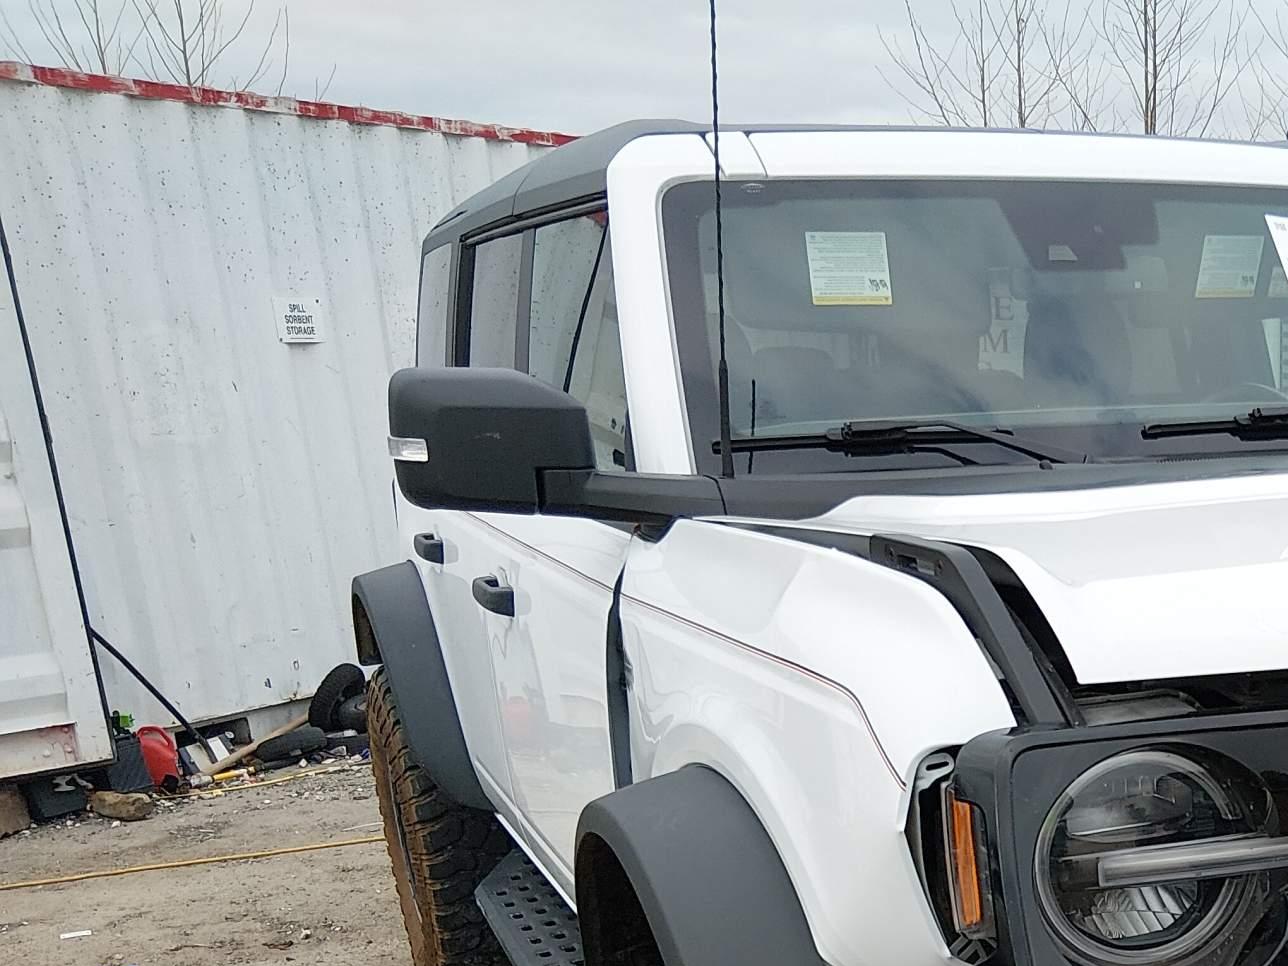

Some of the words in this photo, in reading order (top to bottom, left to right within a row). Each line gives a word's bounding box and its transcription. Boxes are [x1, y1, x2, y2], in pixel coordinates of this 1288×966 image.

[288, 303, 306, 313] SPILL
[284, 314, 313, 324] SORBENT
[286, 325, 316, 336] STORAGE
